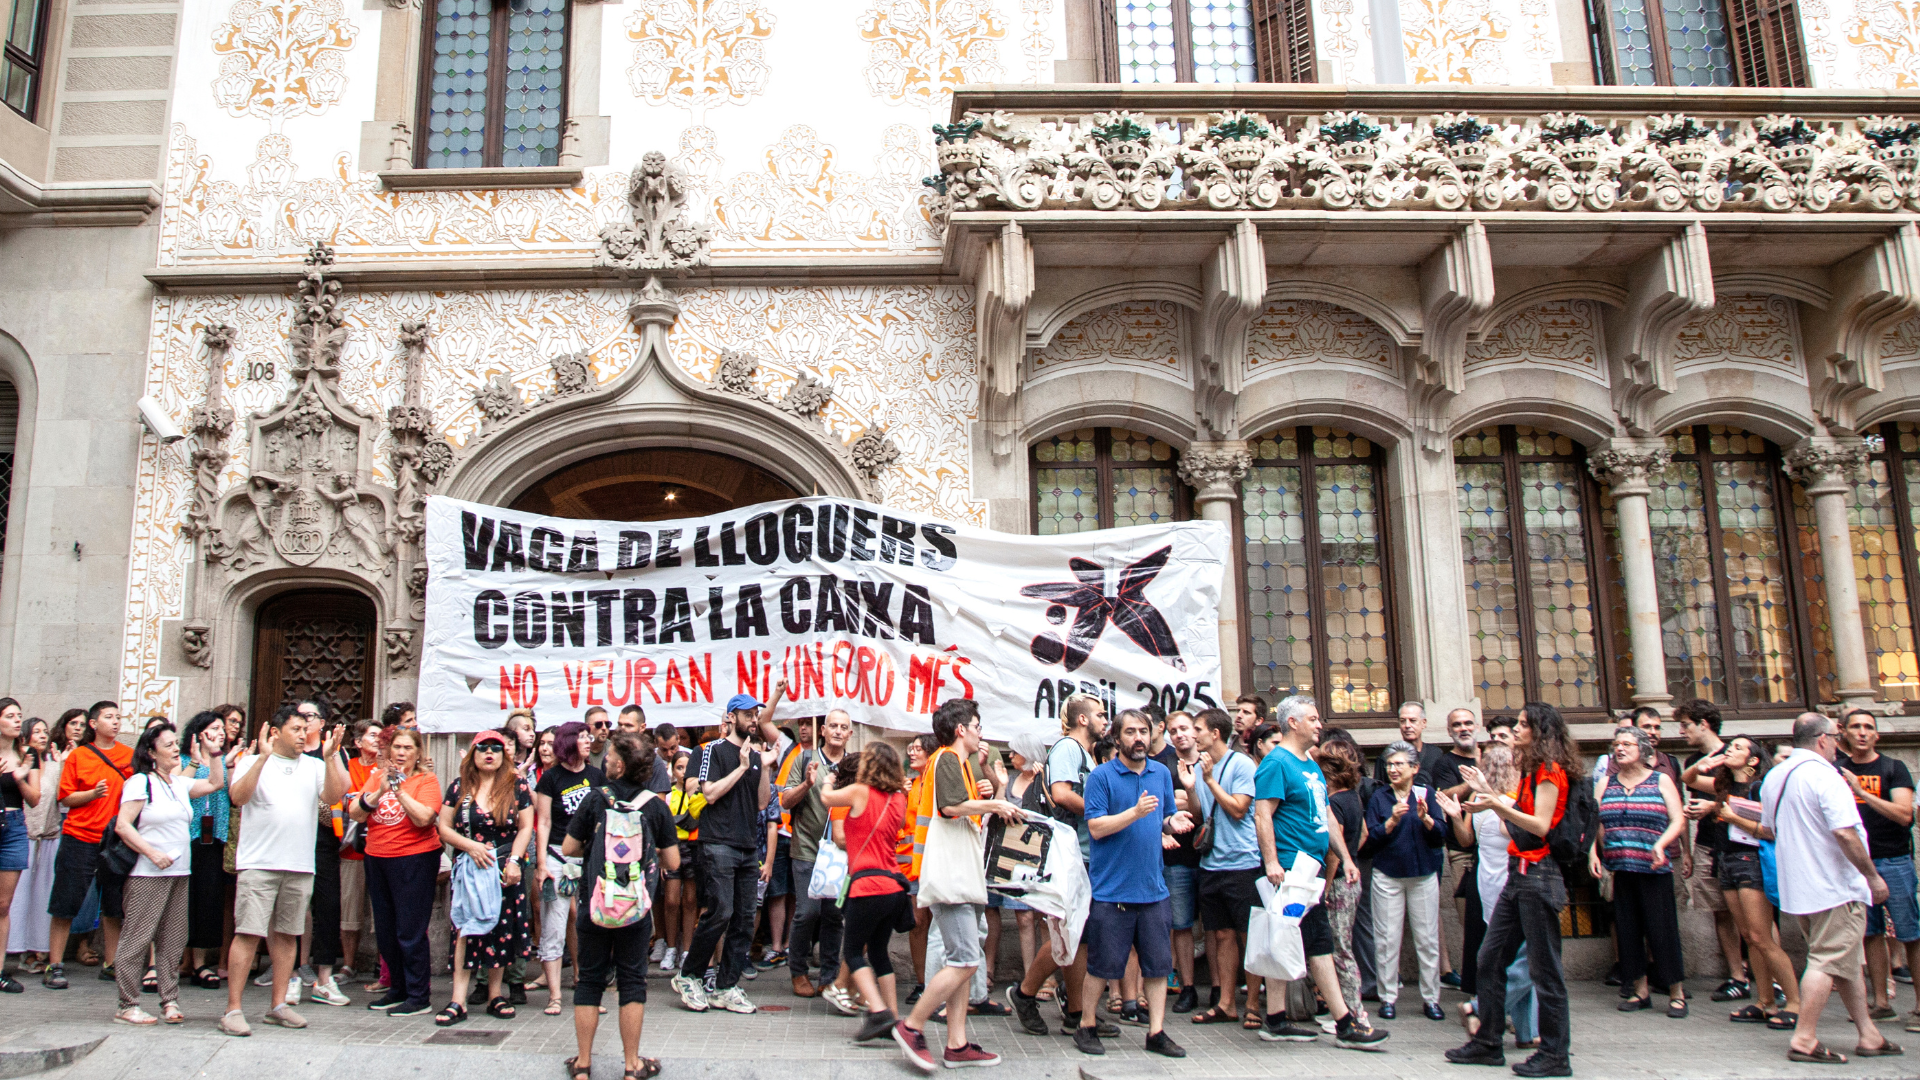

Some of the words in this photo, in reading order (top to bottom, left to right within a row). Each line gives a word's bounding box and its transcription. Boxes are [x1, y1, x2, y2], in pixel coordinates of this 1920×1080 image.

[246, 361, 276, 381] 108
[461, 510, 600, 573] VAGA
[616, 528, 683, 570] DE
[693, 503, 958, 572] LLOGUERS
[473, 588, 697, 649] CONTRA
[708, 583, 770, 640] LA
[780, 574, 936, 645] CAIXA
[500, 663, 539, 710] NO
[562, 652, 714, 708] VEURAN
[783, 642, 825, 702] UN
[832, 640, 895, 706] EURO
[906, 644, 974, 714] MÉS
